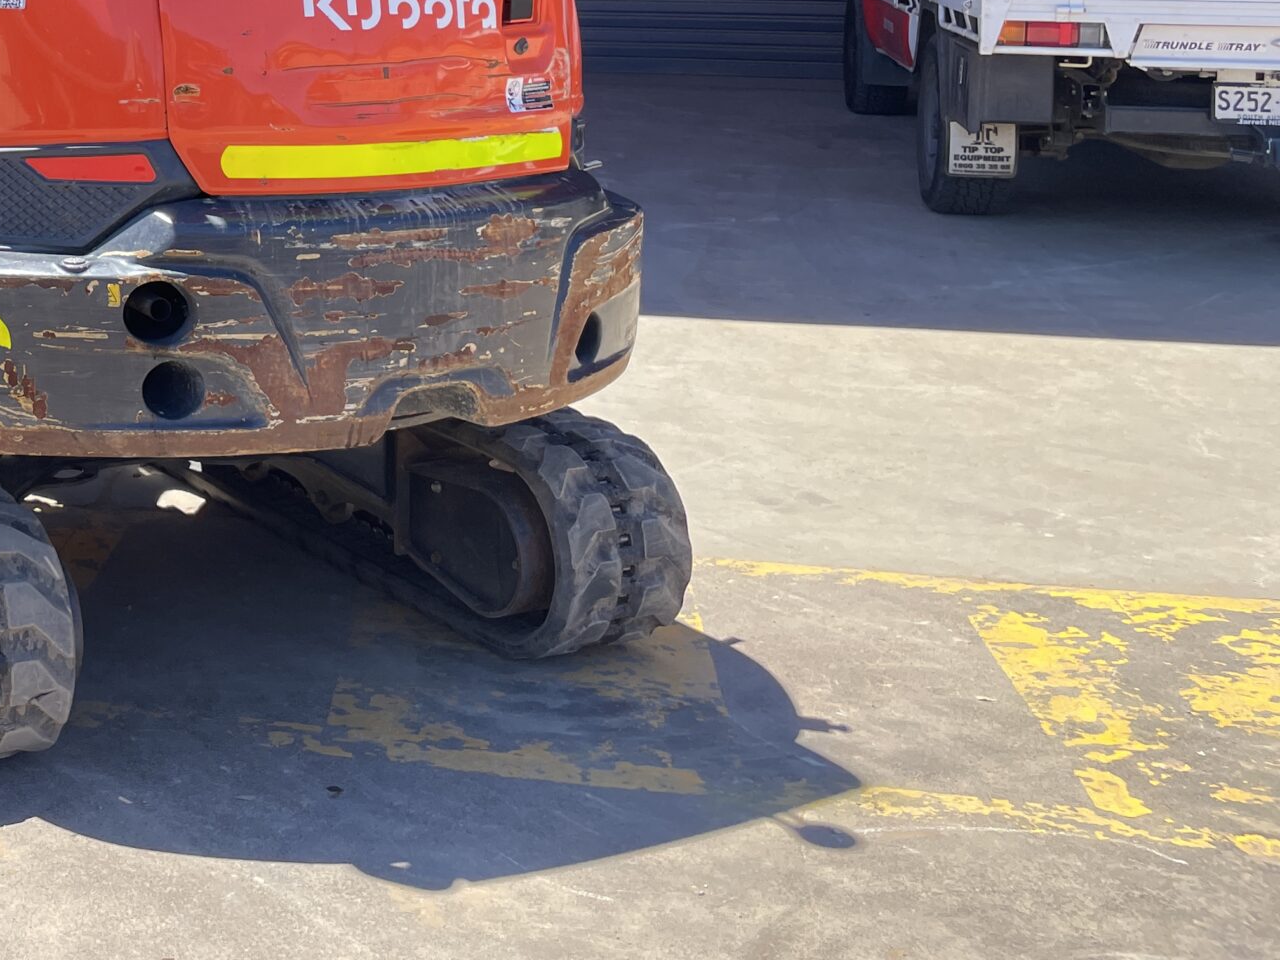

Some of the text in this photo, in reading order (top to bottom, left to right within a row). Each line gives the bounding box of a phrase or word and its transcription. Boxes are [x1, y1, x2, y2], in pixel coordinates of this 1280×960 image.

[1153, 41, 1262, 52] TRUNDLE TRAY
[961, 145, 1004, 154] TIP TOP
[953, 154, 1011, 162] EQUIPMENT
